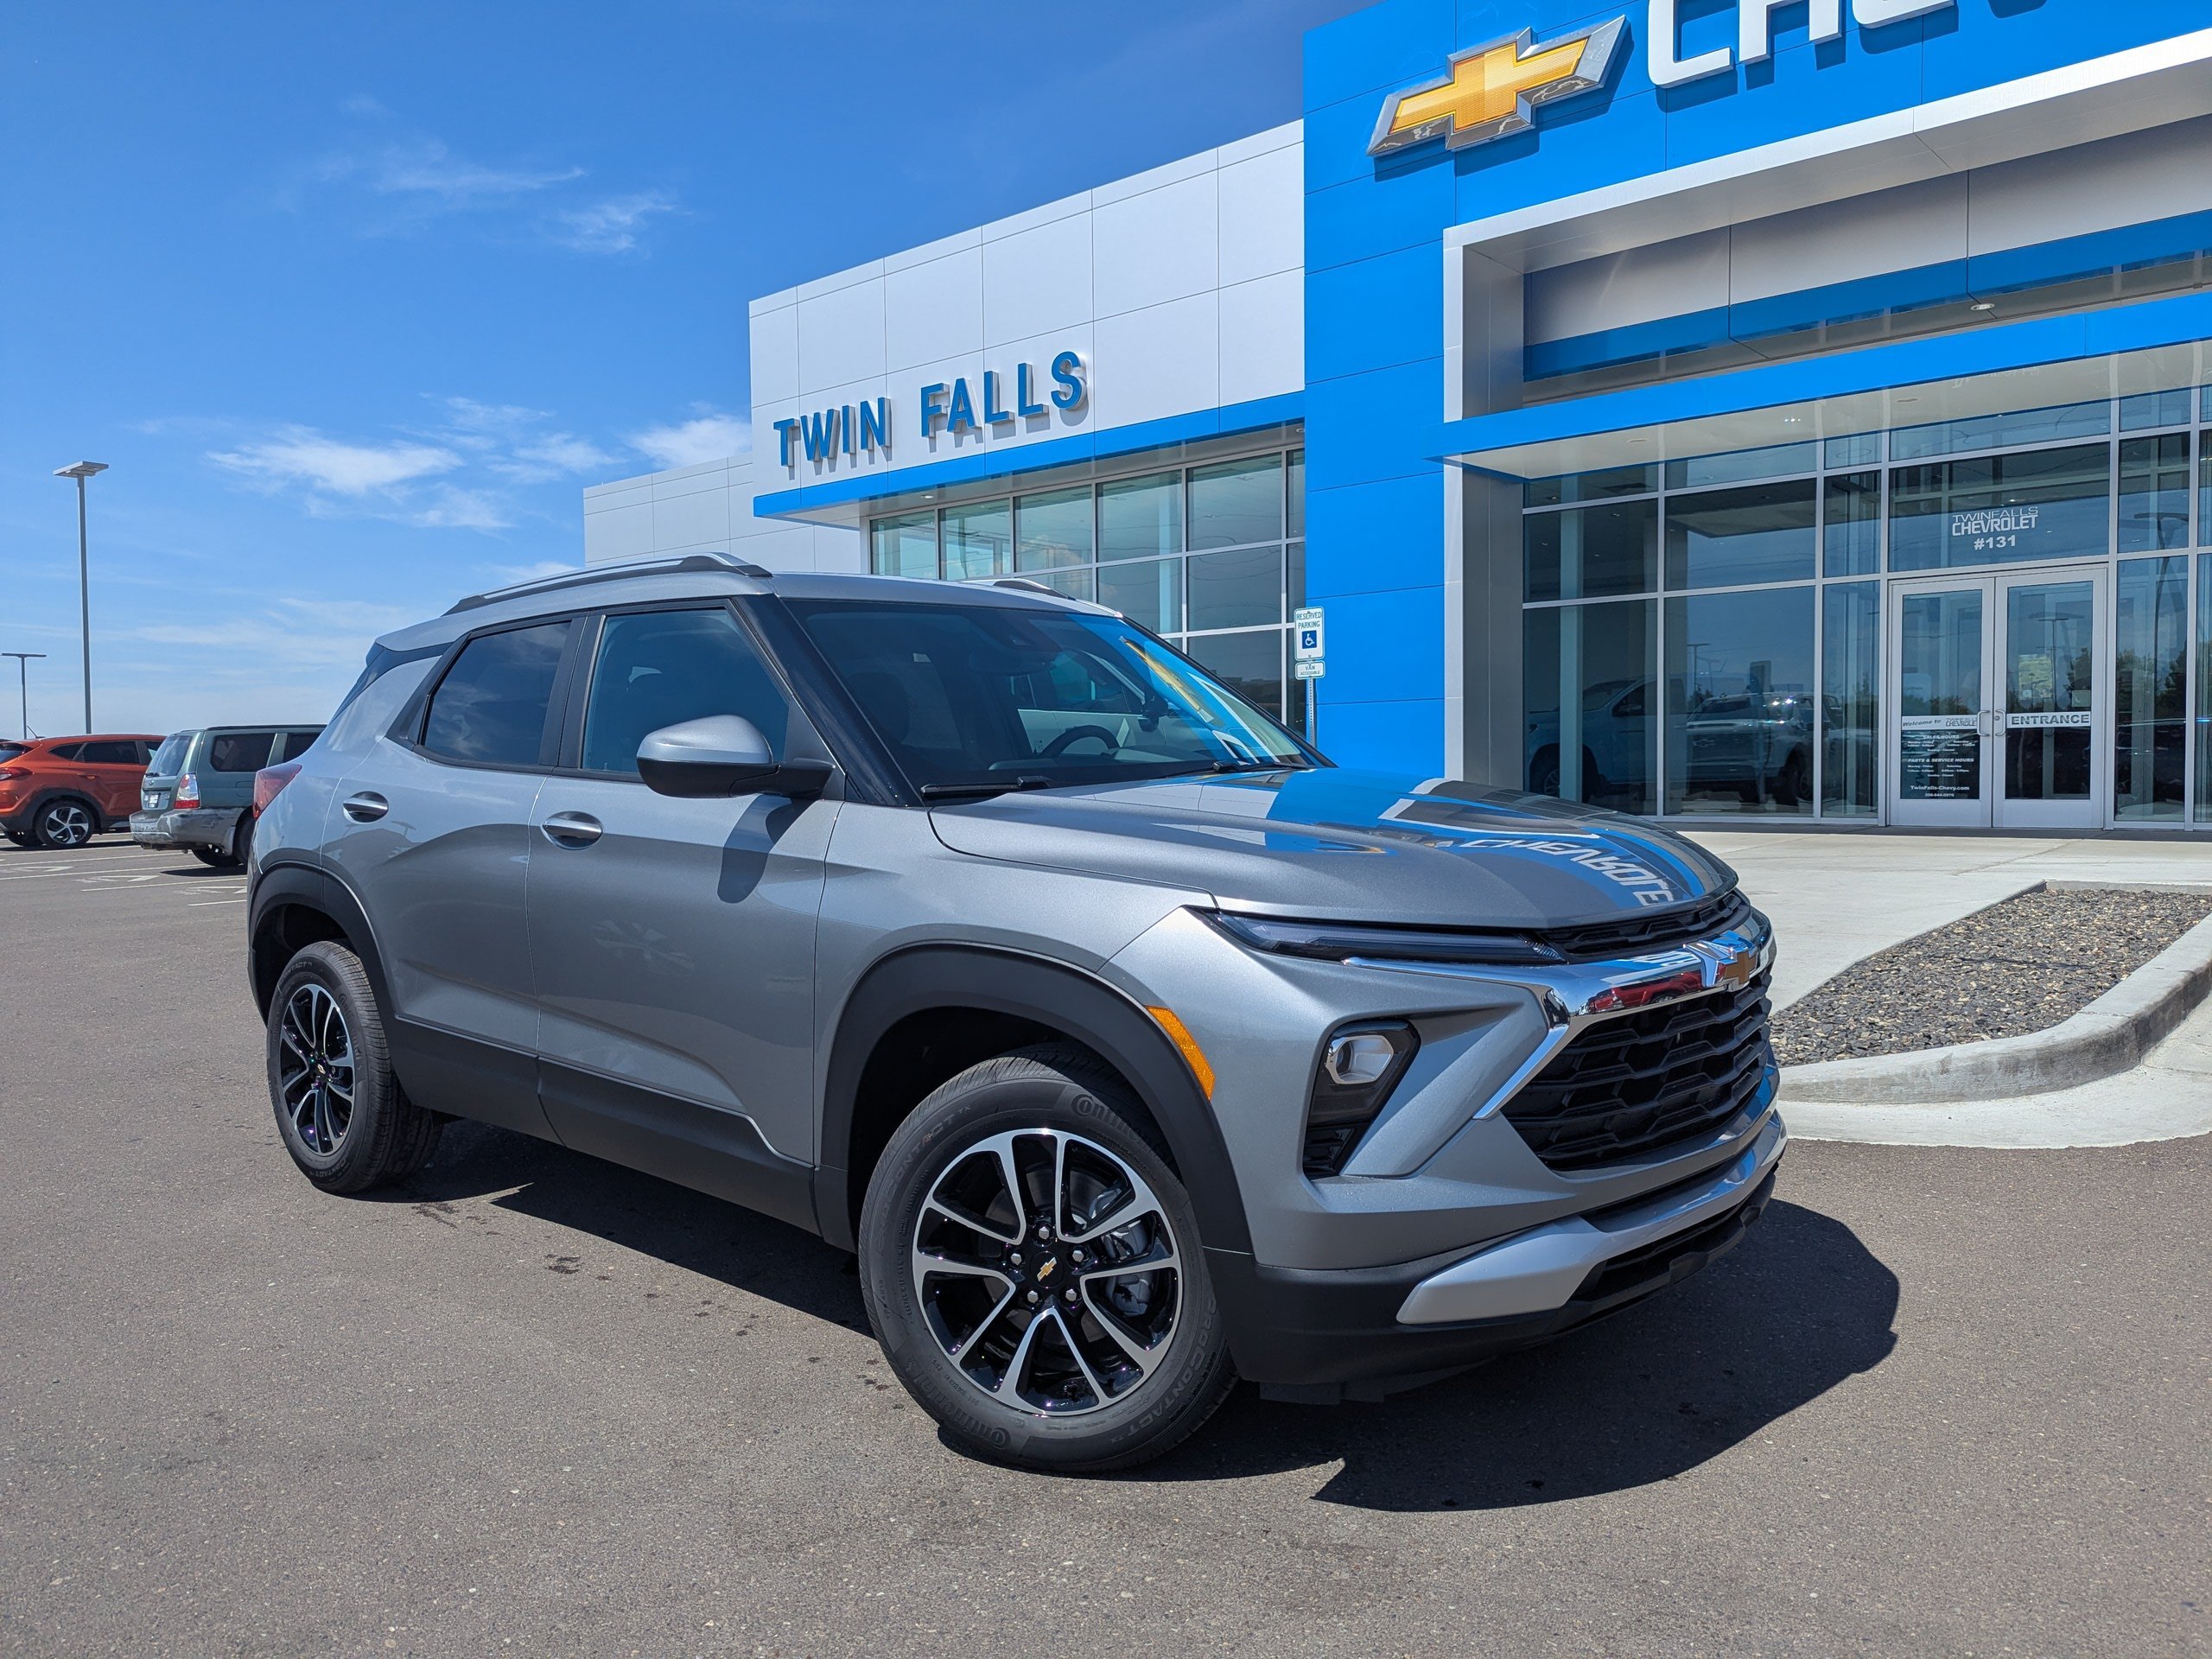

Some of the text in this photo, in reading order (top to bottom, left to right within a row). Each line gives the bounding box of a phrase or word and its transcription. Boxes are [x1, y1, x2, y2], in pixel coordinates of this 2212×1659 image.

[772, 350, 1089, 467] TWIN FALLS
[1952, 514, 2039, 537] CHEVROLET
[1974, 534, 2017, 550] #131
[1296, 611, 1322, 620] RESERVED
[1298, 620, 1320, 629] PARKING
[2011, 714, 2090, 726] ENTRANCE
